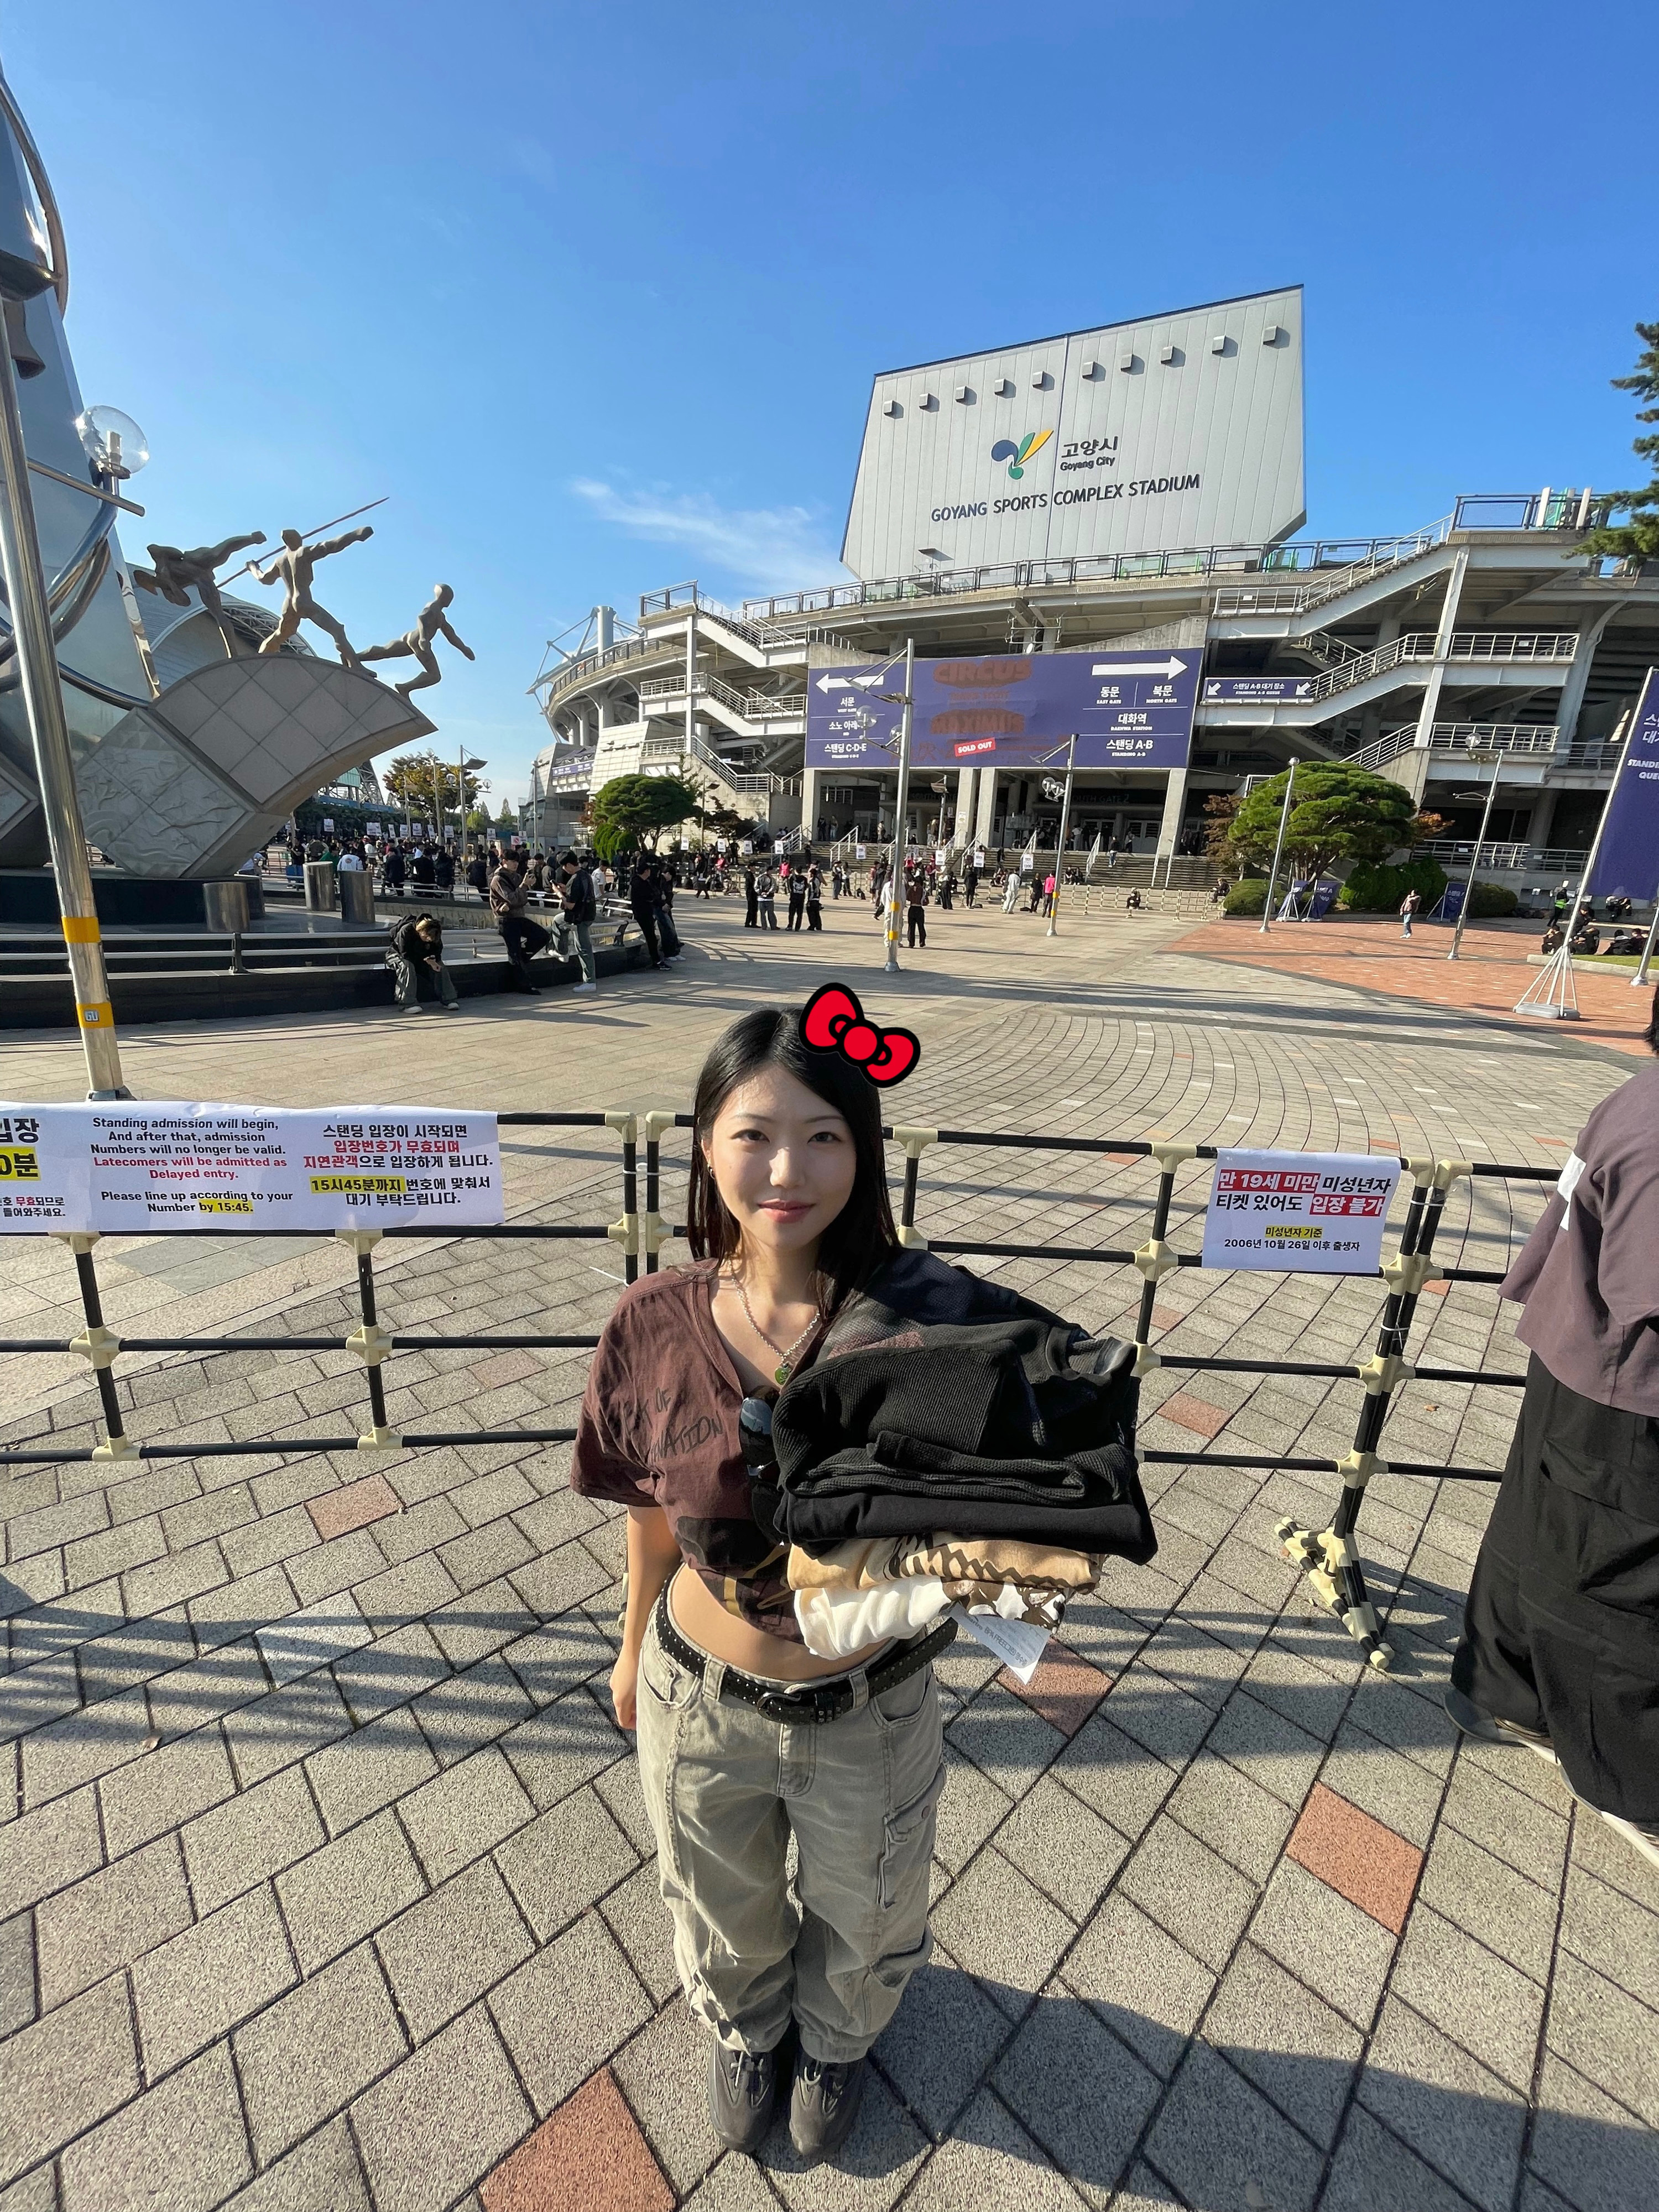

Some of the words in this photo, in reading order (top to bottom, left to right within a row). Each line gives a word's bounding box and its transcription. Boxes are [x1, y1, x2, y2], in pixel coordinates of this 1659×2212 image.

[1061, 436, 1119, 458] 고양시
[1060, 458, 1094, 472] Goyang
[1096, 455, 1115, 468] City
[931, 502, 987, 522] GOYANG
[993, 493, 1047, 514] SPORTS
[1053, 483, 1124, 506] COMPLEX
[1129, 473, 1200, 495] STADIUM
[1100, 686, 1120, 698] 동문
[1152, 685, 1172, 697] 북문
[841, 697, 855, 707] 서문
[1118, 713, 1147, 724] 대화역
[1644, 714, 1659, 727] 스
[829, 721, 843, 730] 소노
[844, 720, 863, 730] 아레
[825, 743, 845, 753] 스탠딩
[958, 745, 976, 754] SOLD
[977, 741, 992, 750] OUT
[1106, 739, 1134, 750] 스탠딩
[93, 1118, 148, 1130] Standing
[152, 1119, 212, 1128] admission
[217, 1119, 238, 1129] will
[242, 1120, 278, 1131] begin,
[109, 1131, 132, 1141] And
[136, 1131, 166, 1141] after
[171, 1132, 201, 1142] that,
[205, 1133, 265, 1141] admission
[324, 1125, 363, 1138] 스탠딩
[368, 1125, 409, 1138] 입장이
[415, 1125, 468, 1138] 시작되면
[91, 1144, 146, 1154] Numbers
[150, 1144, 171, 1154] will
[194, 1144, 231, 1156] longer
[235, 1145, 249, 1154] be
[253, 1145, 285, 1154] valid.
[333, 1140, 403, 1153] 입장번호가
[406, 1140, 460, 1153] 무효되며
[93, 1157, 168, 1166] Latecomers
[171, 1157, 194, 1166] will
[198, 1157, 212, 1166] be
[216, 1157, 270, 1166] admitted
[303, 1155, 385, 1168] 지연관객으로
[390, 1155, 444, 1168] 입장하게
[448, 1154, 493, 1167] 됩니다.
[149, 1169, 200, 1180] Delayed
[204, 1171, 238, 1181] entry.
[311, 1178, 401, 1192] 15시45분까지
[406, 1177, 446, 1191] 번호에
[451, 1176, 491, 1189] 맞춰서
[1219, 1172, 1237, 1190] 만
[1241, 1173, 1280, 1191] 19세
[1285, 1173, 1319, 1191] 미만
[1322, 1176, 1391, 1194] 미성년자
[0, 1197, 13, 1206] 호
[16, 1197, 65, 1206] 무효되므로
[101, 1191, 142, 1200] Please
[145, 1191, 167, 1200] line
[171, 1193, 186, 1202] up
[190, 1191, 248, 1202] according
[267, 1193, 294, 1202] your
[346, 1193, 371, 1207] 대기
[376, 1192, 461, 1206] 부탁드립니다.
[147, 1203, 195, 1212] Number
[199, 1202, 213, 1213] by
[218, 1203, 253, 1212] 15:45.
[1216, 1193, 1249, 1211] 티켓
[1254, 1194, 1303, 1212] 있어도
[1312, 1196, 1346, 1213] 입장
[1348, 1196, 1384, 1215] 불가
[1265, 1227, 1302, 1238] 미성년자
[1304, 1227, 1322, 1238] 기준
[1224, 1239, 1261, 1249] 2006년
[1264, 1240, 1285, 1250] 10월
[1288, 1240, 1310, 1250] 26일
[1313, 1240, 1331, 1250] 이후
[1333, 1241, 1360, 1251] 출생자
